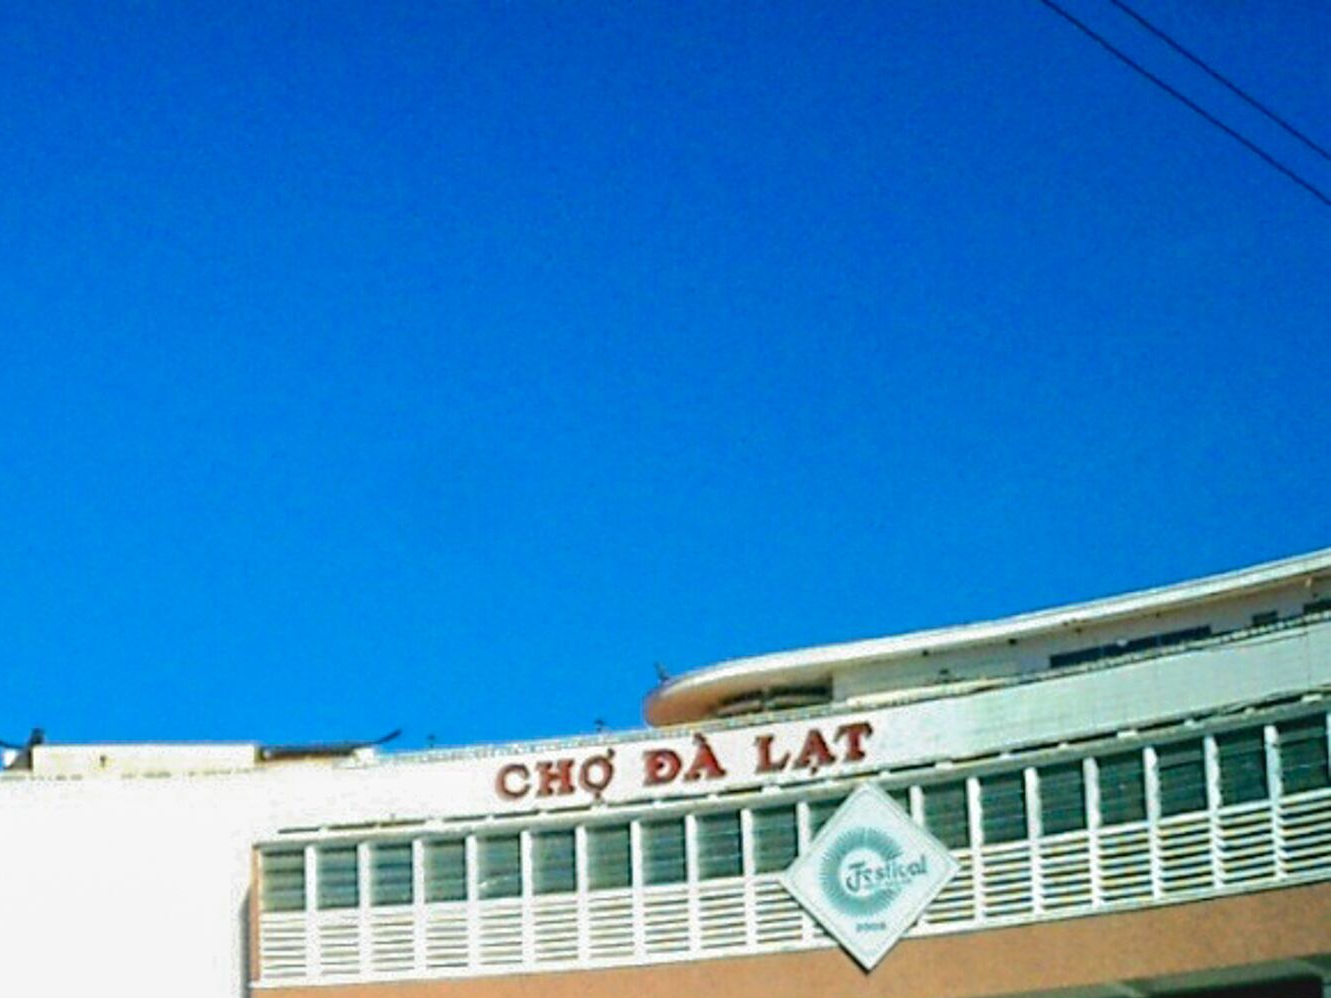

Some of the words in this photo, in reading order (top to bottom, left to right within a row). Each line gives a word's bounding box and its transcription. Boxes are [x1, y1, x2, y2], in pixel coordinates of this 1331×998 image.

[494, 748, 616, 802] CHỢ
[642, 732, 726, 786] ĐÀ
[755, 721, 874, 776] LẠT
